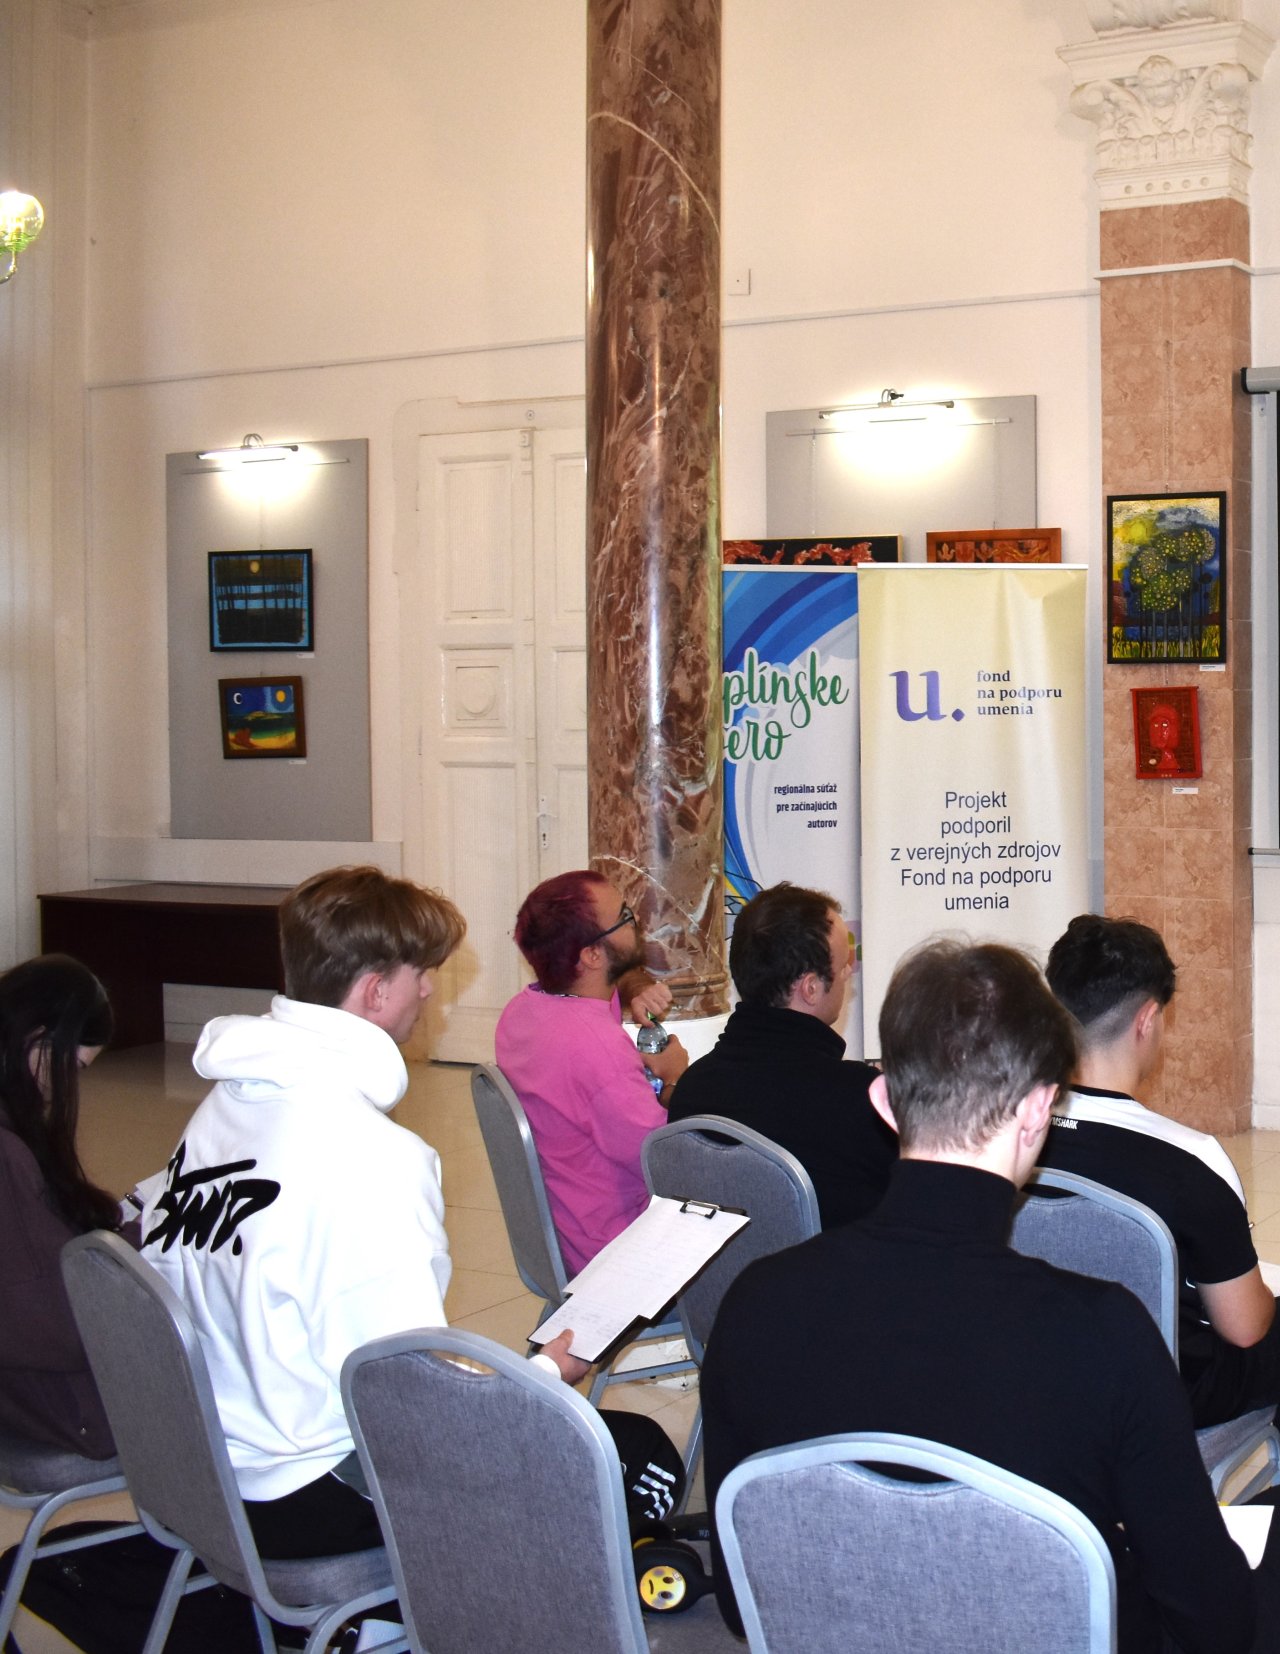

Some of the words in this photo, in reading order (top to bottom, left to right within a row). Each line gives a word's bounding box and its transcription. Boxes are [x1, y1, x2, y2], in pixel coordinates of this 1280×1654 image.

[976, 669, 1012, 683] fond
[976, 688, 996, 699] na
[999, 686, 1063, 702] podporu
[976, 702, 1034, 716] umenia
[722, 719, 793, 761] ero
[773, 784, 816, 796] regionálna
[816, 782, 838, 795] súťaž
[776, 803, 790, 813] pre
[790, 800, 838, 813] začínajúcich
[945, 790, 1008, 813] Projekt
[807, 818, 838, 829] autorov
[940, 815, 1012, 839] podporil
[890, 847, 902, 861] z
[905, 841, 992, 865] verejných
[997, 840, 1062, 862] zdrojov
[901, 867, 946, 887] Fond
[952, 870, 974, 886] na
[979, 866, 1052, 889] podporu
[944, 891, 1010, 911] umenia
